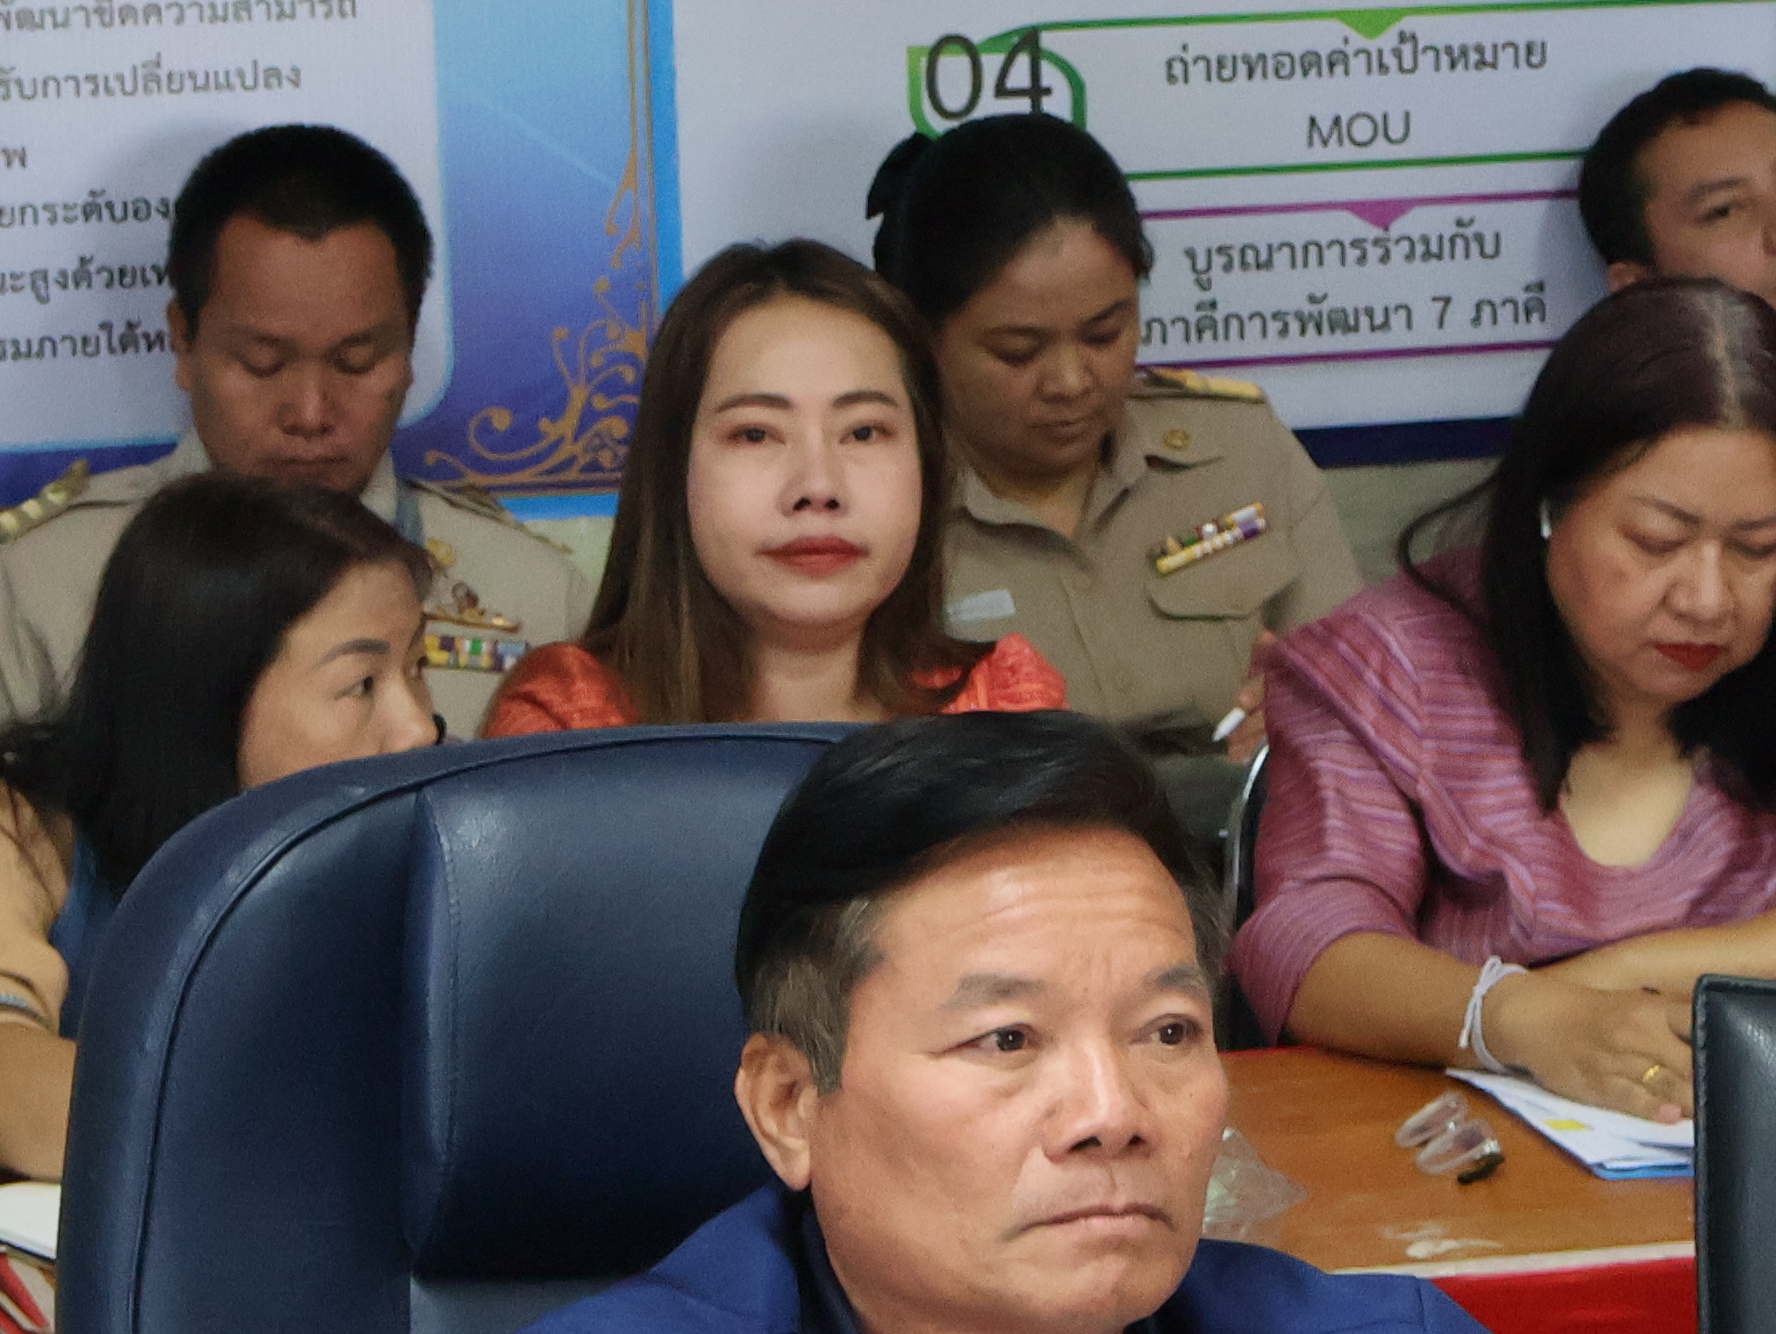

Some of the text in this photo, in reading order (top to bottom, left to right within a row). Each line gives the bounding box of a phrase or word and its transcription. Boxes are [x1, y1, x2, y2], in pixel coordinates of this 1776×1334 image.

[925, 27, 1053, 121] 04
[1164, 33, 1548, 88] ถ่ายทอดค่าเป้าหมาย
[1307, 110, 1412, 148] MOU
[1186, 220, 1502, 290] บูรณาการร่วมกับ
[1142, 280, 1549, 348] ภาคีการพัฒนา 7 ภาคี
